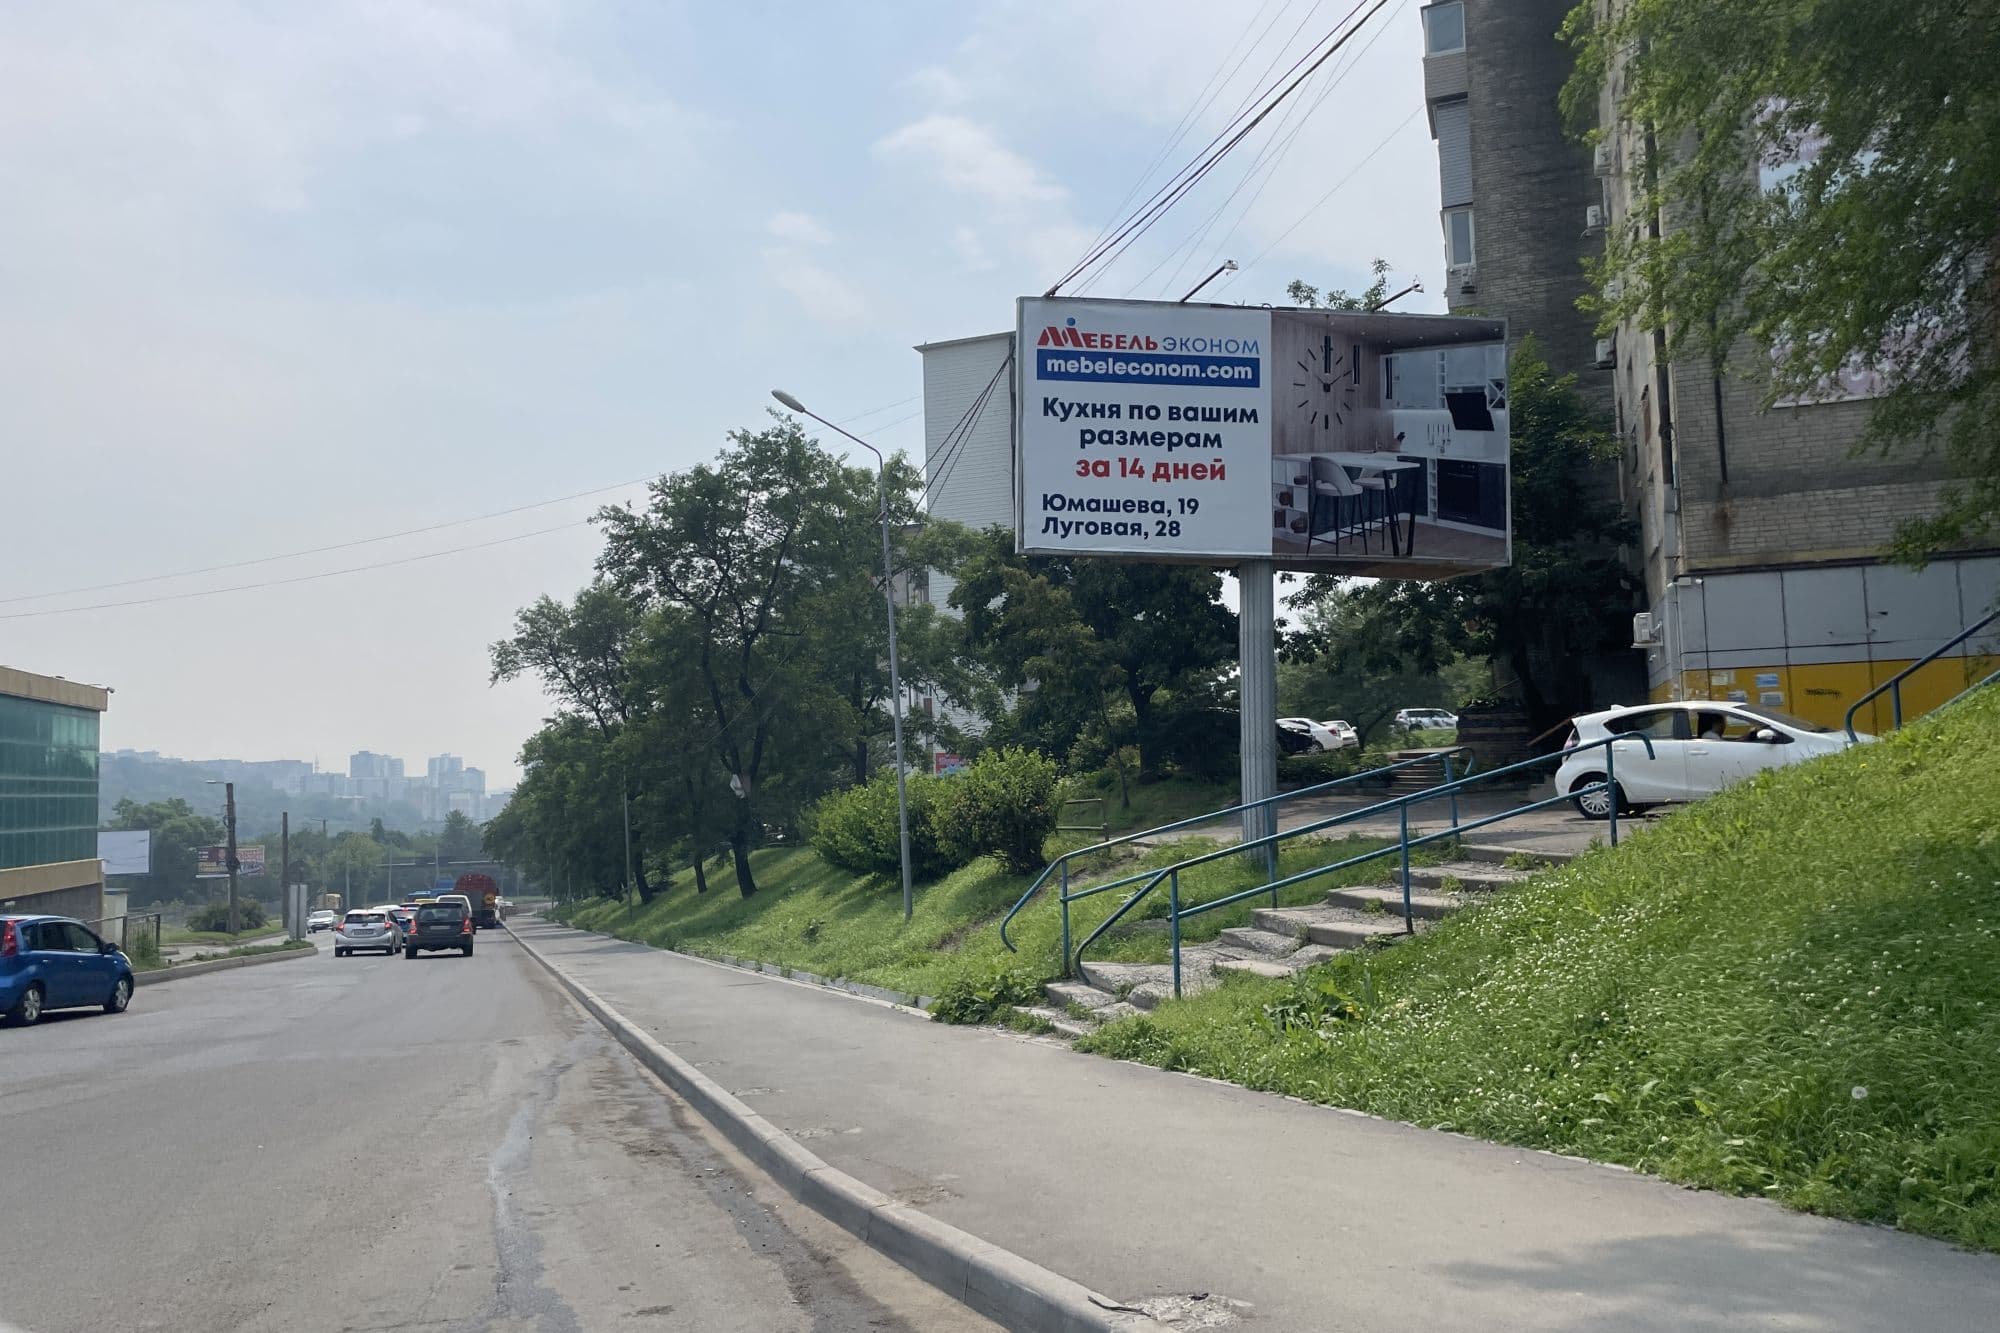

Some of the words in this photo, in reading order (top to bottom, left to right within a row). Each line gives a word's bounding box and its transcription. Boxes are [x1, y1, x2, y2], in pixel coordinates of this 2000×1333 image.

[1047, 357, 1253, 379] mebeleconom.com
[1043, 397, 1121, 422] Кухня
[1129, 404, 1161, 421] по
[1168, 405, 1259, 424] вашим
[1080, 428, 1223, 452] размерам
[1076, 459, 1110, 477] за
[1118, 457, 1145, 479] 14
[1152, 458, 1226, 483] дней
[1042, 493, 1172, 518] Юмашева,
[1178, 498, 1200, 515] 19
[1042, 517, 1149, 539] Луговая,
[1155, 520, 1181, 537] 28
